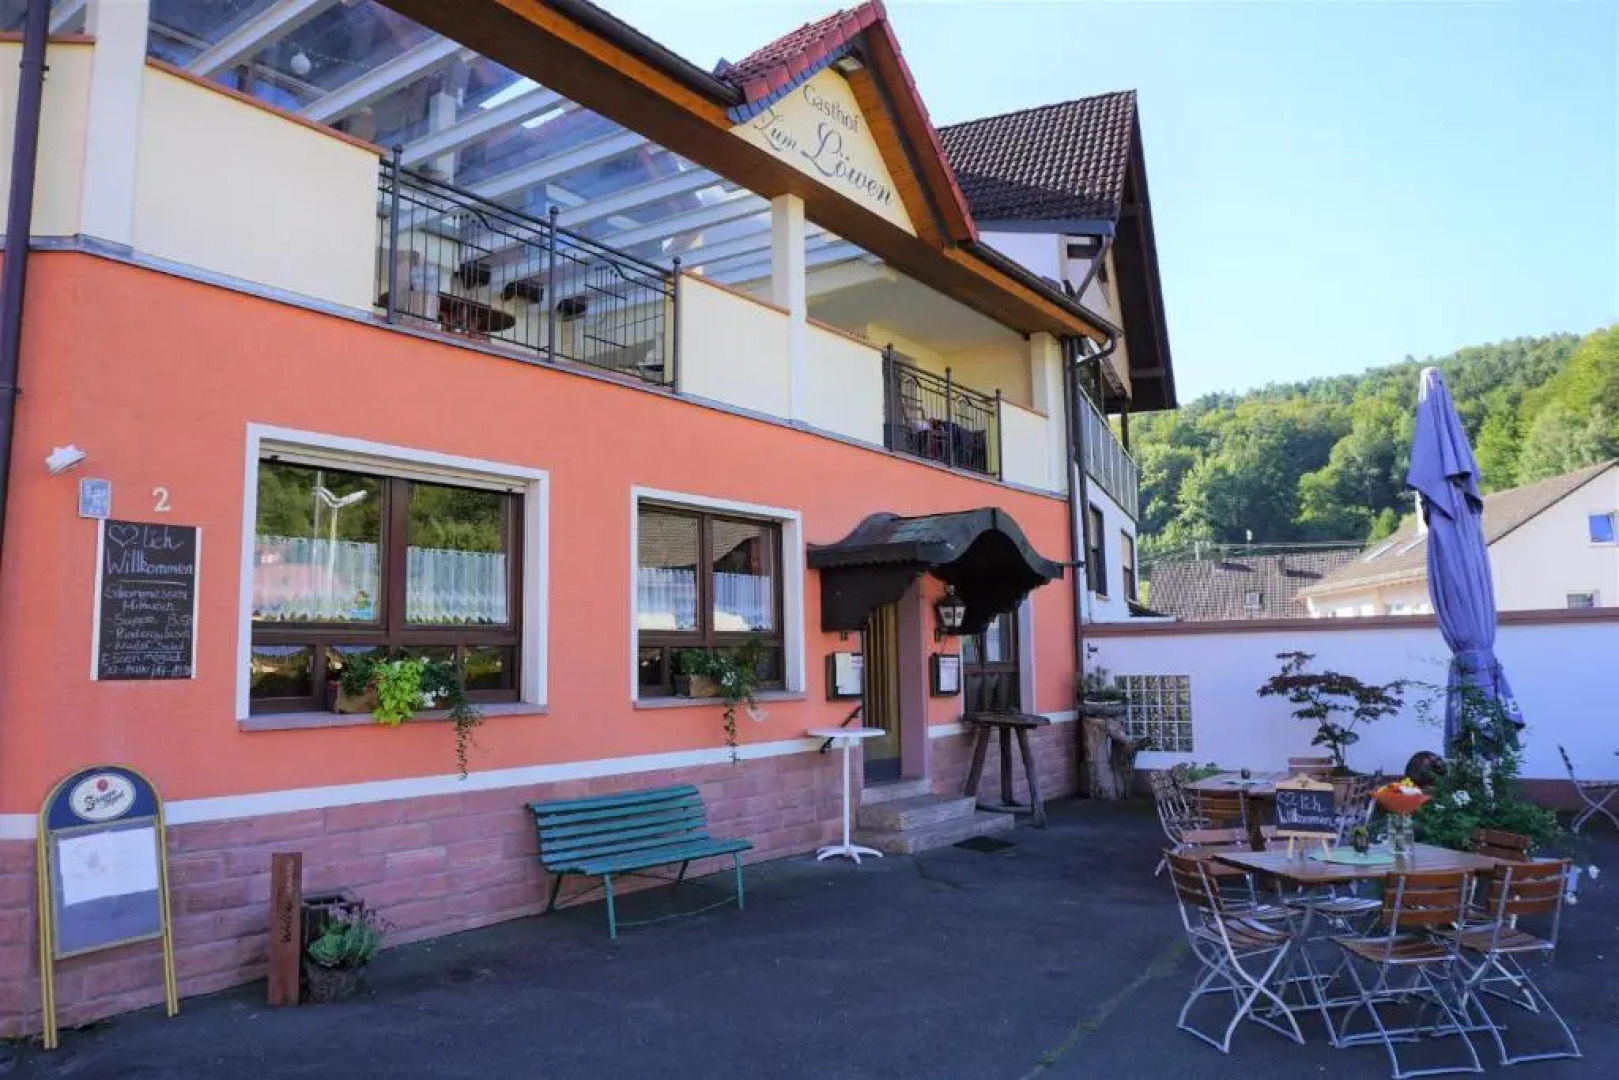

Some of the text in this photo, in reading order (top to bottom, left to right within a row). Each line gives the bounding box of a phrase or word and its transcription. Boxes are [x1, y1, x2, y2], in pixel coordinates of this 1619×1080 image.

[803, 84, 858, 133] Gasthof
[753, 107, 892, 205] Zum Löwen
[152, 486, 171, 512] 2
[106, 550, 192, 575] Willkommen
